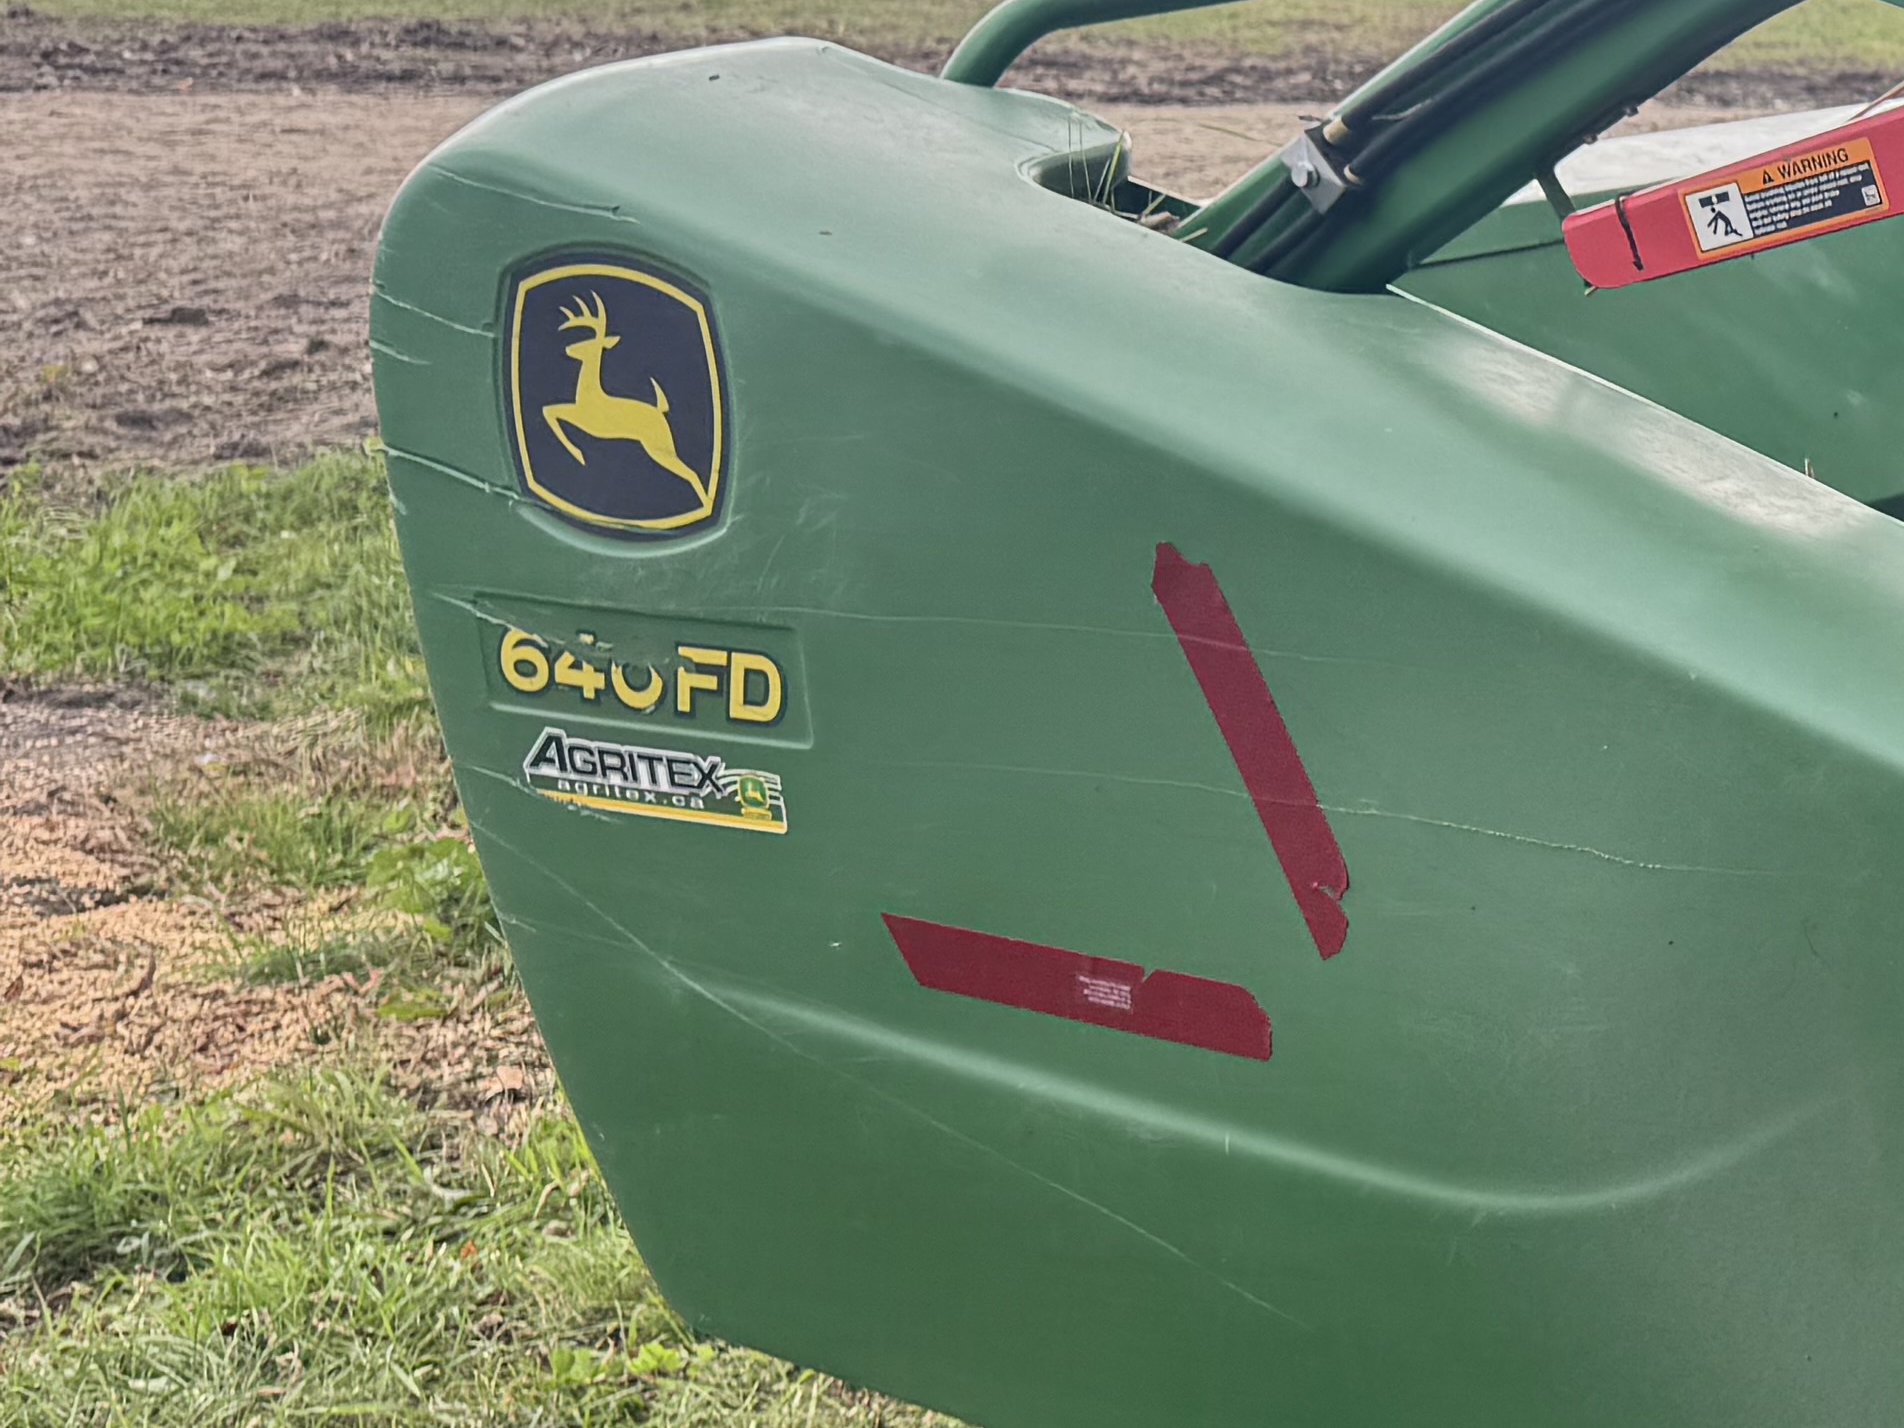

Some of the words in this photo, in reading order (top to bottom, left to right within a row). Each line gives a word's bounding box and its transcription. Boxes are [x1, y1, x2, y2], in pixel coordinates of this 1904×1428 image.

[1777, 148, 1849, 179] WARNING
[527, 733, 725, 794] AGRITEX
[557, 779, 705, 810] agritex.ca
